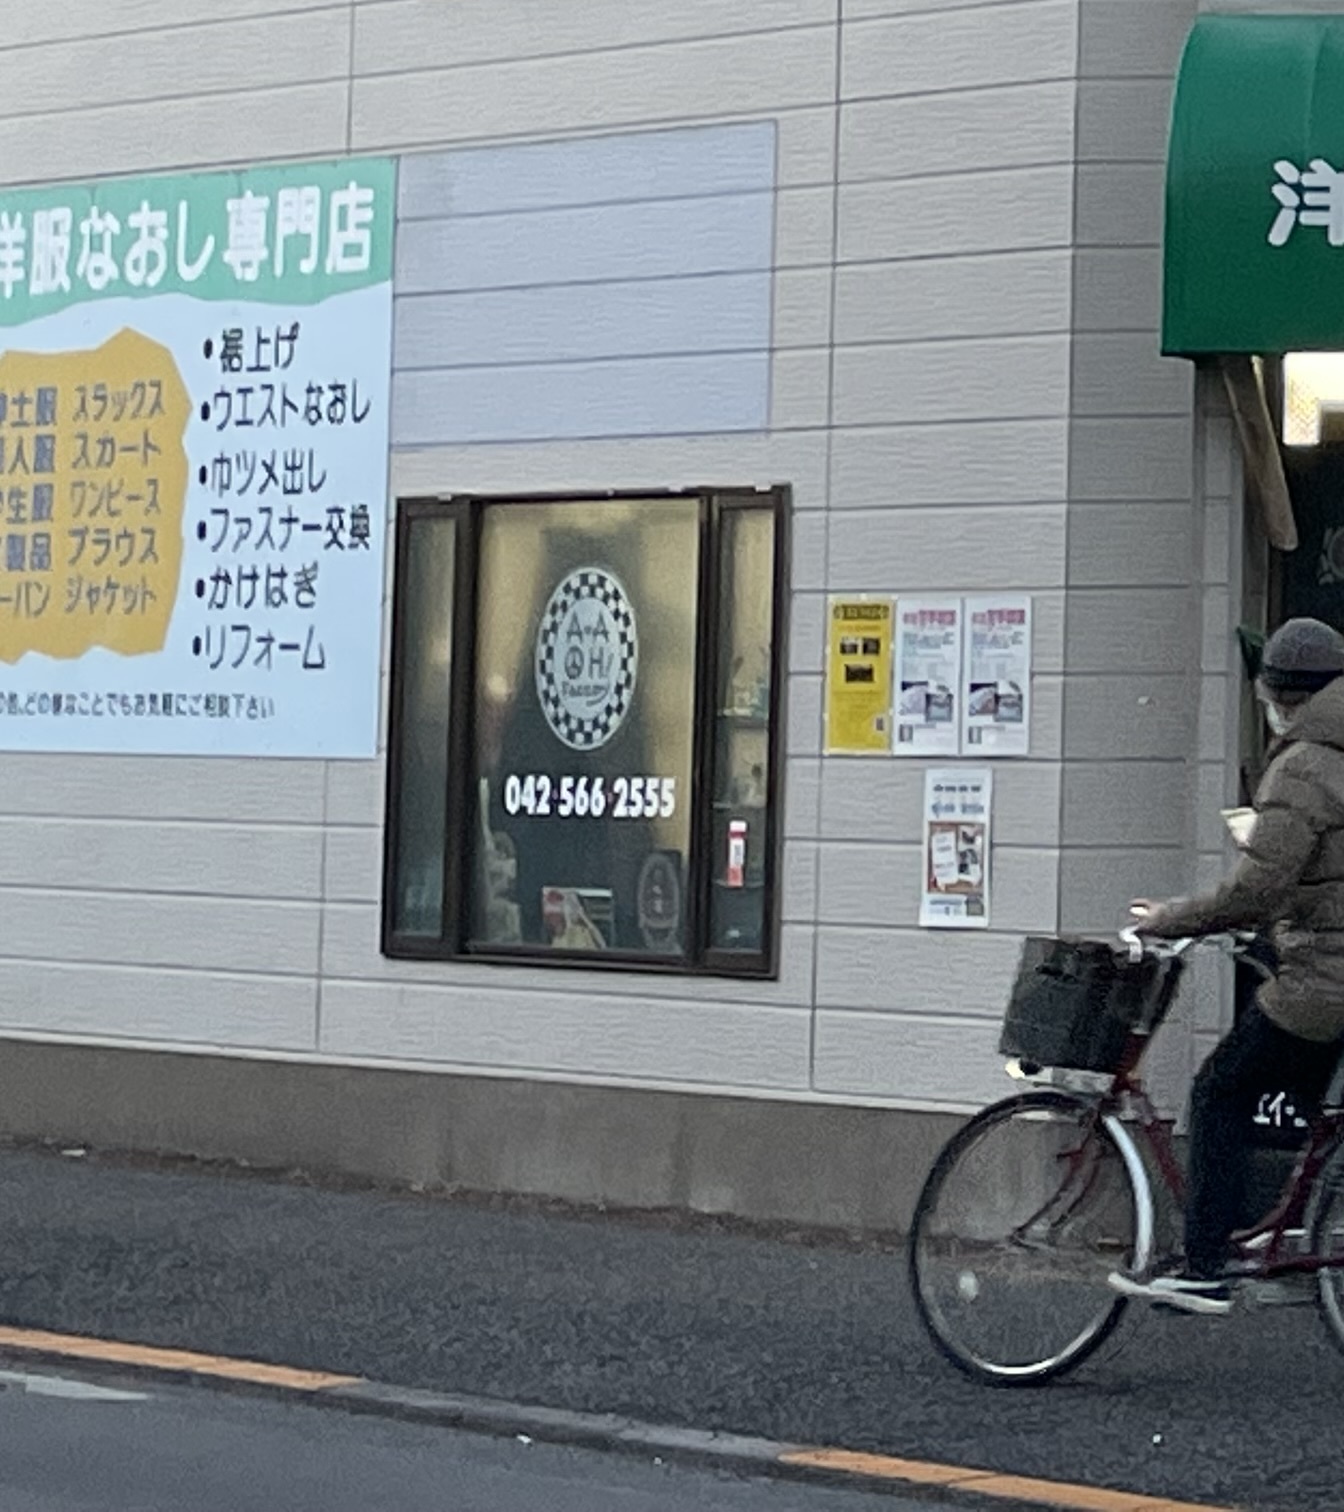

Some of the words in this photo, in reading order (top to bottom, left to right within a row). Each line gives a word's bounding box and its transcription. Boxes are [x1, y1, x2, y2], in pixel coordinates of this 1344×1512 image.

[219, 322, 301, 373] 裾上げ
[72, 380, 165, 422] スラックス
[213, 378, 372, 432] ウエストなおし
[0, 434, 56, 475] 人服
[71, 429, 161, 470] スカート
[0, 483, 54, 524] 生服
[69, 478, 161, 518] ワンピース
[67, 527, 158, 567] ブラウス
[210, 504, 371, 553] ファスナー交換
[65, 575, 157, 616] ジャケット
[207, 561, 320, 610] かけはぎ
[204, 625, 326, 672] リフォーム
